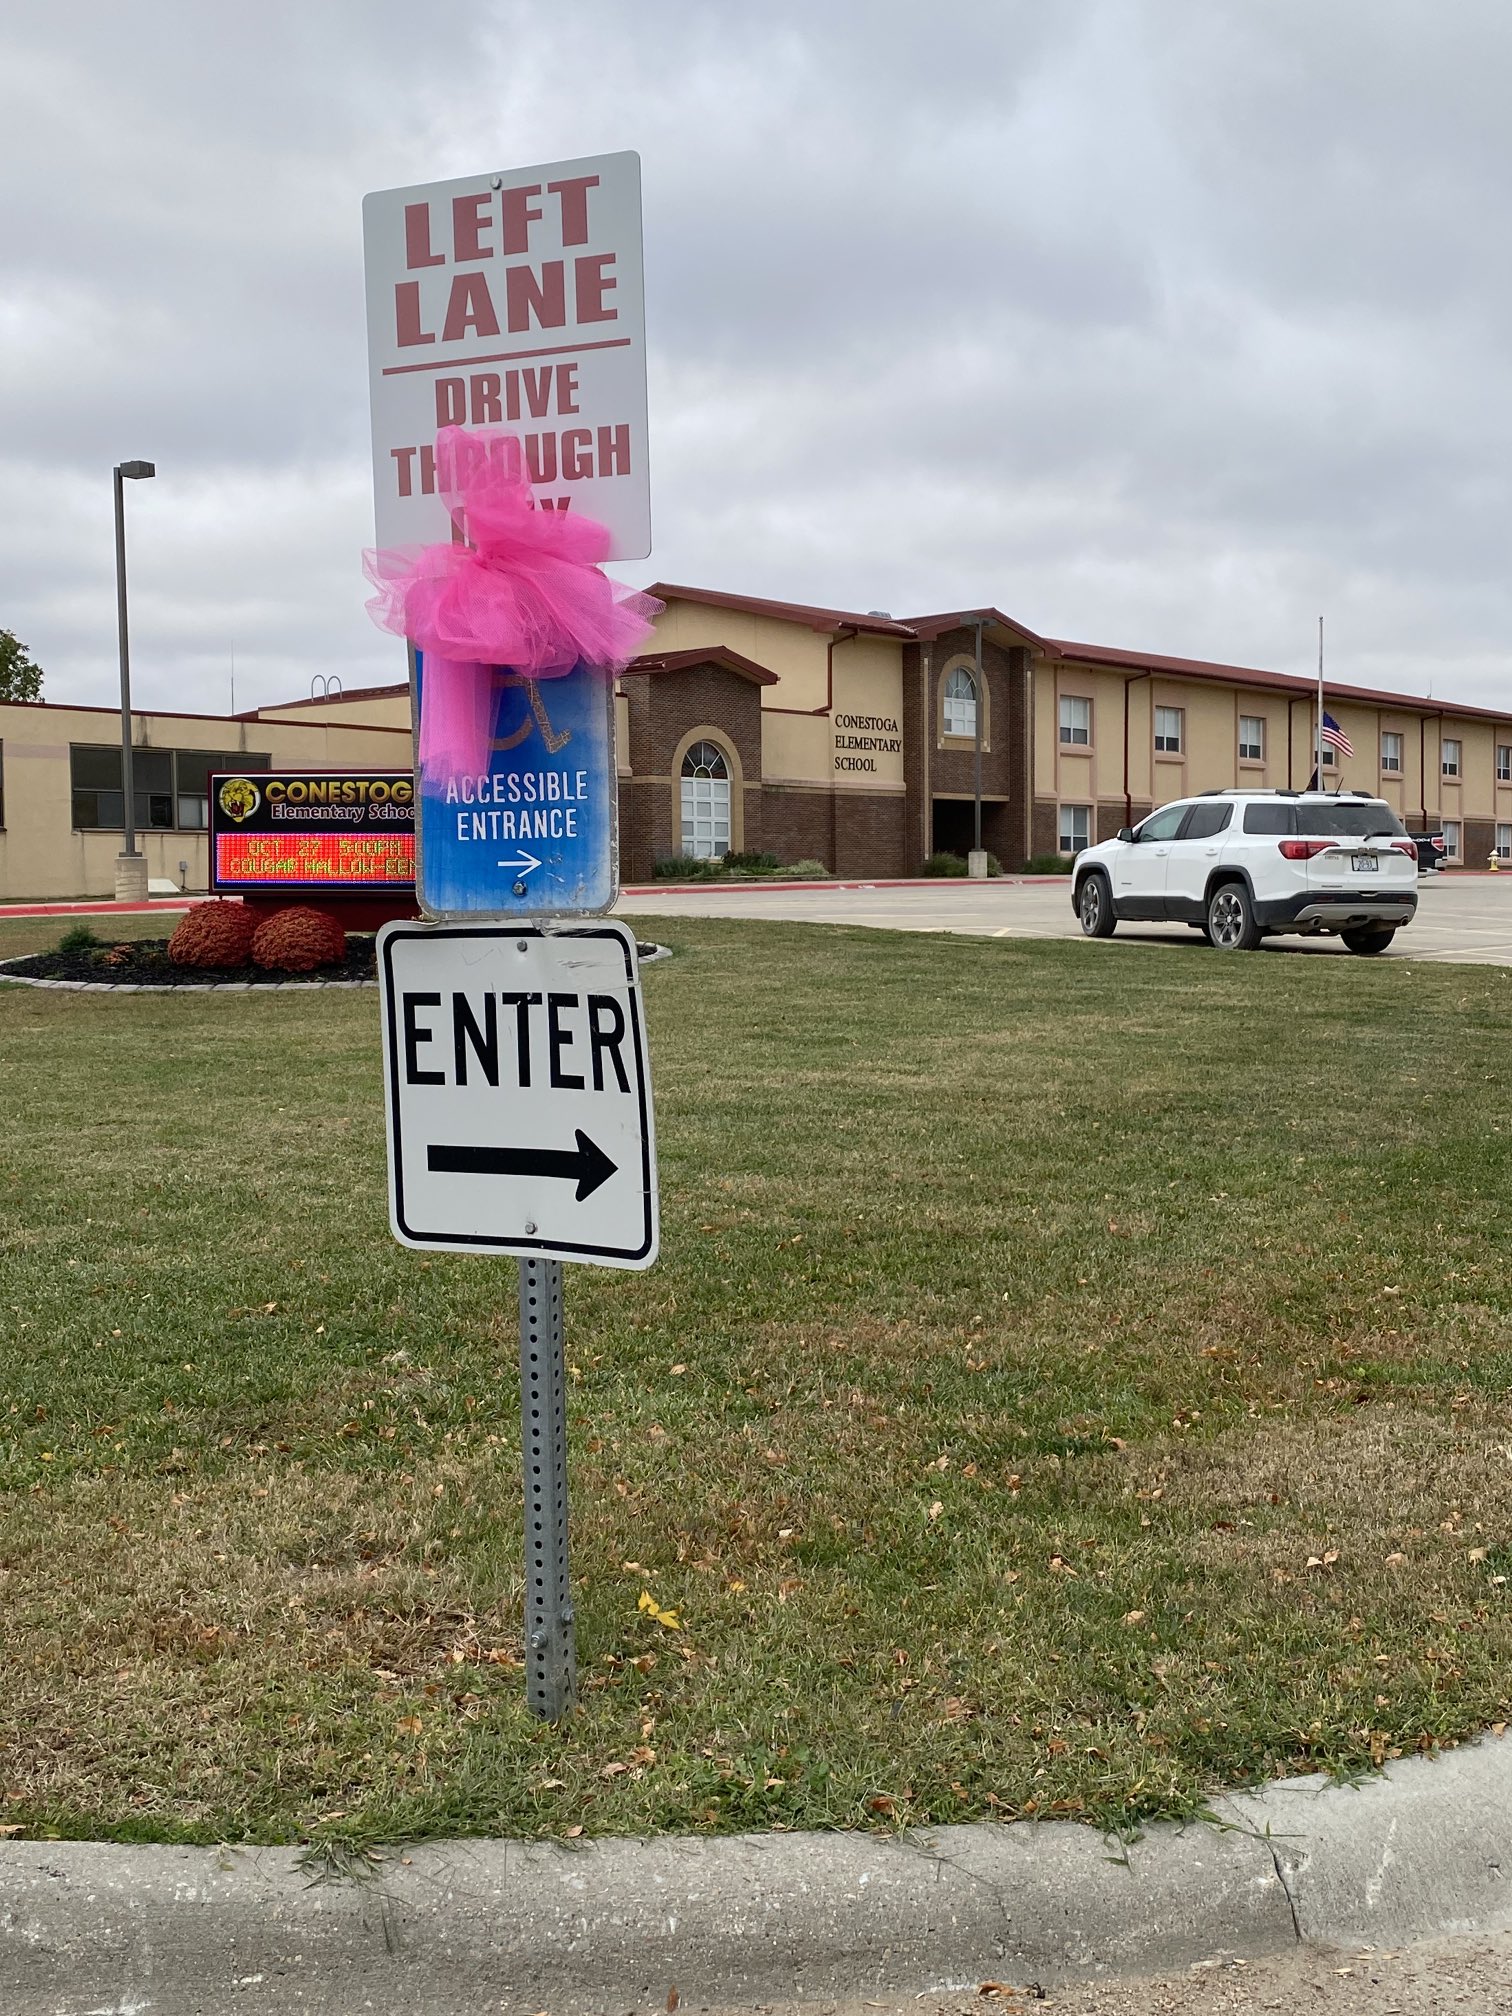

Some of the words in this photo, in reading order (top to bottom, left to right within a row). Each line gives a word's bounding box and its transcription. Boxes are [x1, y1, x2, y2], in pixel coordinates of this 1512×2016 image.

[405, 175, 600, 269] LEFT
[395, 253, 618, 348] LANE
[435, 362, 580, 429] DRIVE
[390, 424, 631, 497] THROUGH
[835, 714, 898, 732] CONESTOGA
[835, 735, 902, 752] ELEMENTARY
[834, 756, 877, 772] SCHOOL
[265, 781, 415, 804] CONESTOG
[446, 770, 588, 804] ACCESSIBLE
[271, 803, 365, 823] Elementary
[369, 803, 415, 820] Schoo
[457, 808, 577, 841] ENTRANCE
[298, 840, 321, 857] 27
[229, 858, 298, 875] COUGAR
[402, 992, 631, 1093] ENTER
